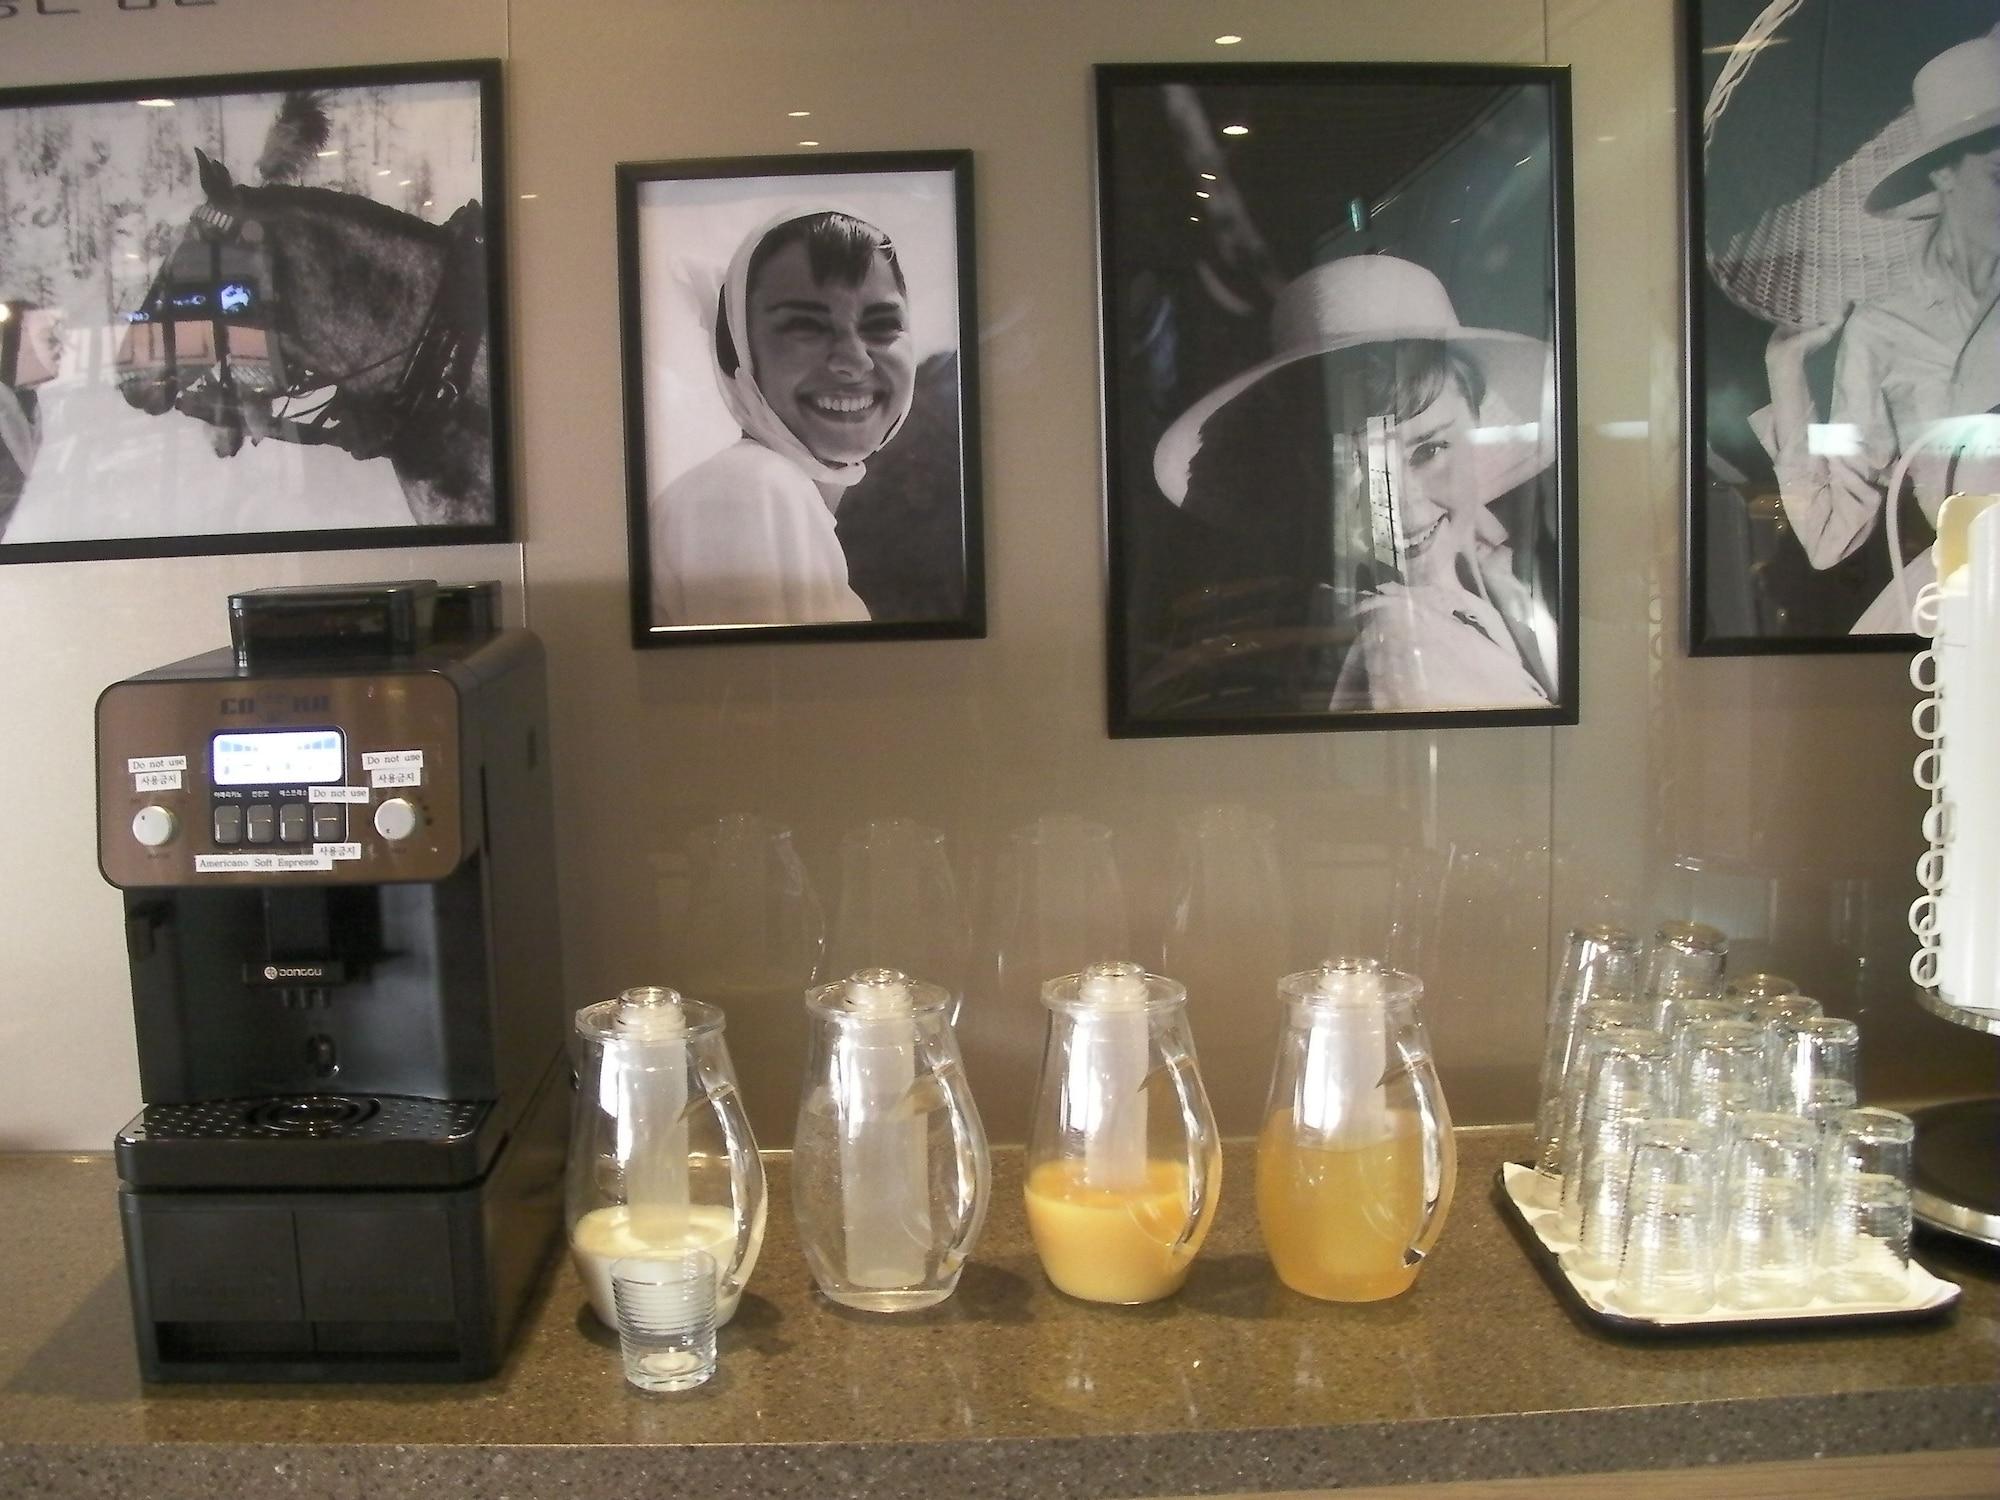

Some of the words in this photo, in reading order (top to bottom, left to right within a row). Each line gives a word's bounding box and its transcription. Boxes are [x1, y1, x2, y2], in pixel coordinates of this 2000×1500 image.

[133, 761, 146, 770] Do
[149, 760, 165, 768] not
[168, 758, 185, 767] use
[367, 756, 380, 765] Do
[384, 755, 400, 763] not
[404, 754, 421, 762] use
[142, 774, 177, 785] 사용금지
[379, 772, 415, 784] 사용금지
[313, 789, 326, 797] Do
[330, 789, 346, 797] not
[319, 846, 355, 857] 사용금지
[199, 858, 249, 868] Americano
[254, 858, 273, 867] Soft
[278, 858, 319, 868] Espresso
